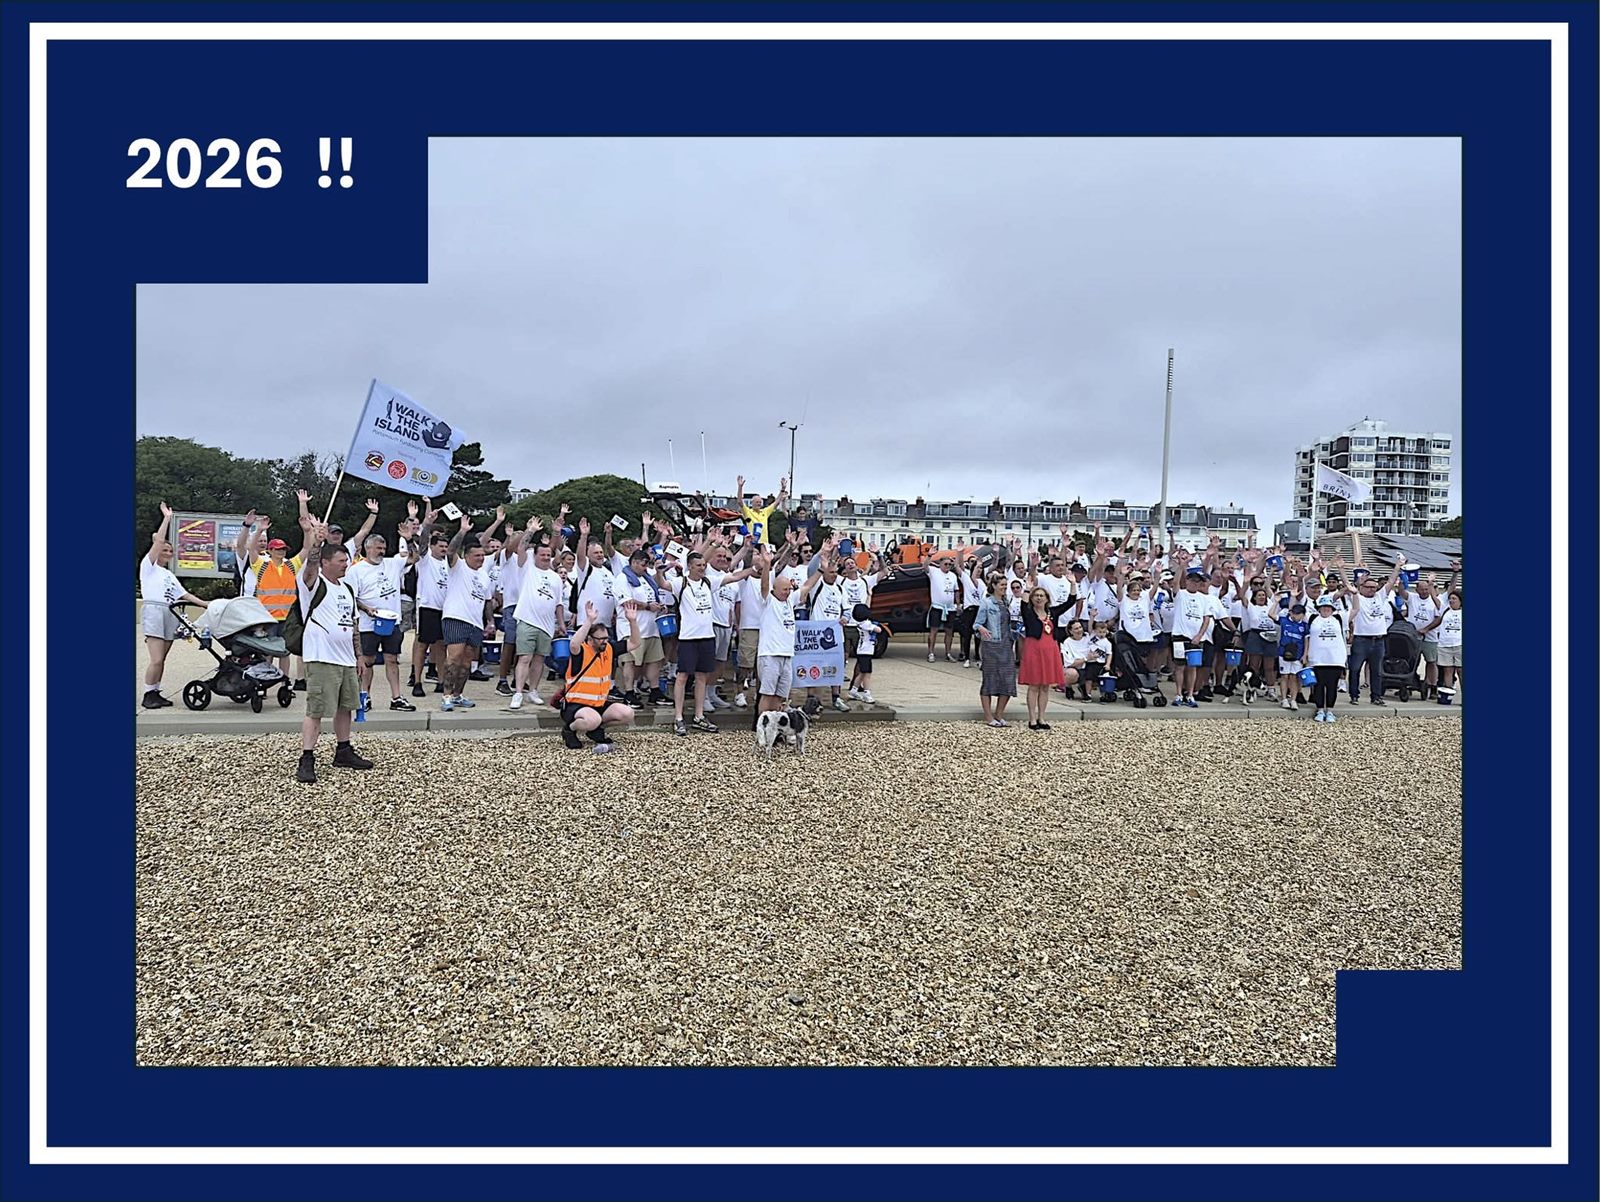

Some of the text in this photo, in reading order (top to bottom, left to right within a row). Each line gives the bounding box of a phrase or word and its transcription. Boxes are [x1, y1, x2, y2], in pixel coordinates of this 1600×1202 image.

[395, 402, 431, 427] WALK
[397, 414, 420, 432] THE
[374, 417, 420, 441] ISLAND
[1323, 484, 1352, 499] BRINY
[794, 643, 819, 651] SLAND
